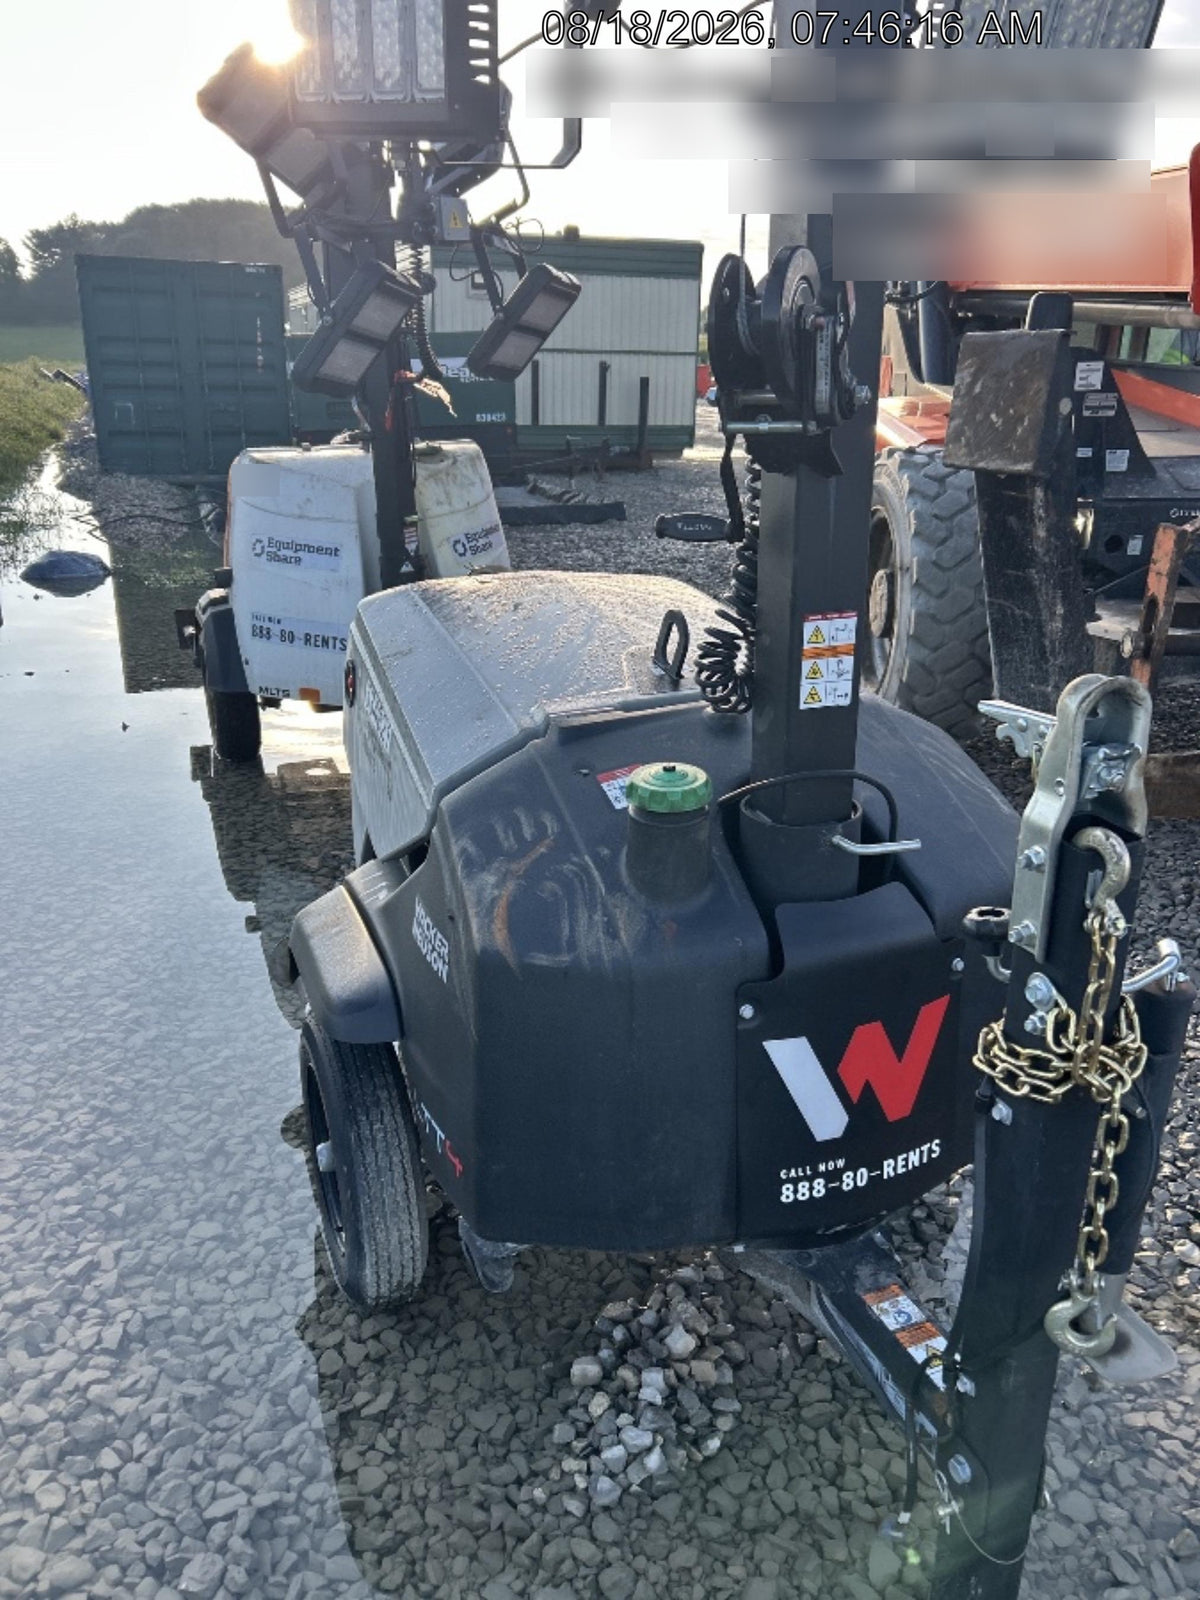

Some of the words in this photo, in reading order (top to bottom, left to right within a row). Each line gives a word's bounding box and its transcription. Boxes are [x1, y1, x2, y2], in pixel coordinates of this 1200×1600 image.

[265, 536, 341, 557] Equipment
[779, 1165, 812, 1180] CALL
[818, 1157, 846, 1173] NOW
[779, 1138, 942, 1203] 888-80-RENTS
